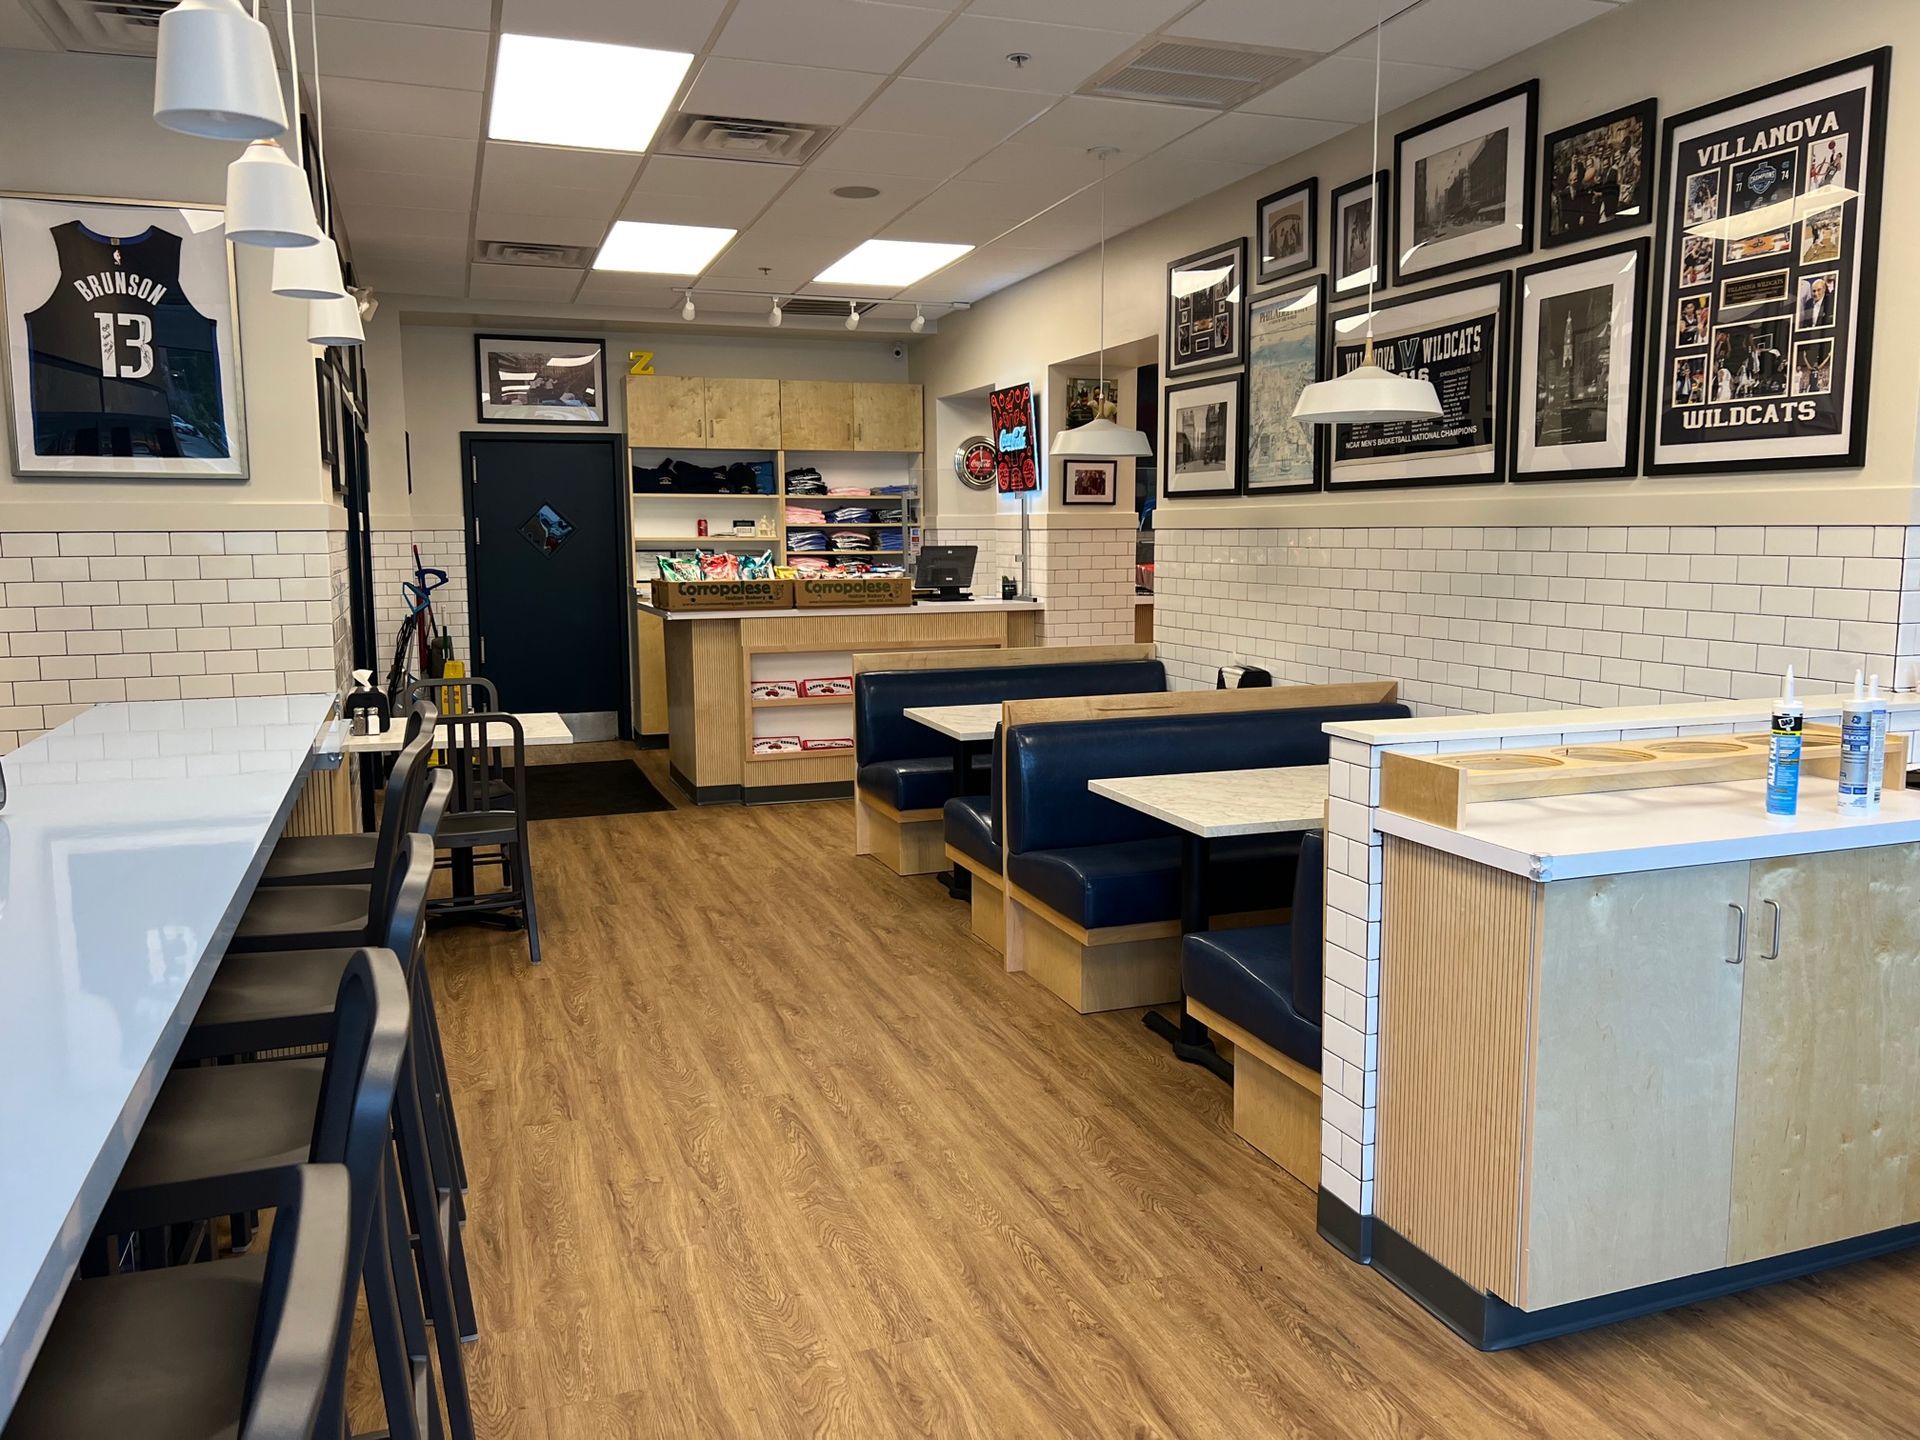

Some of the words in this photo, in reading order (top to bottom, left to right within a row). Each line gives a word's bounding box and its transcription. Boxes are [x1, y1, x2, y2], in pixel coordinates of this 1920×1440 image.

[1697, 110, 1839, 167] VILLANOVA
[1735, 182, 1743, 192] 77
[1781, 170, 1789, 180] 74
[73, 271, 167, 306] BRUNSON
[94, 311, 153, 378] 13
[1422, 324, 1481, 364] WILDCATS
[628, 351, 656, 375] Z
[1682, 400, 1816, 430] WILDCATS
[1361, 438, 1377, 448] MEN'S
[1378, 434, 1411, 446] BASKETBALL
[1411, 431, 1440, 442] NATIONAL
[1440, 425, 1477, 438] CHAMPIONS
[678, 581, 771, 596] Corropolese
[804, 580, 891, 595] Corropolese
[1780, 718, 1793, 727] DAP
[1768, 761, 1776, 786] ALEX
